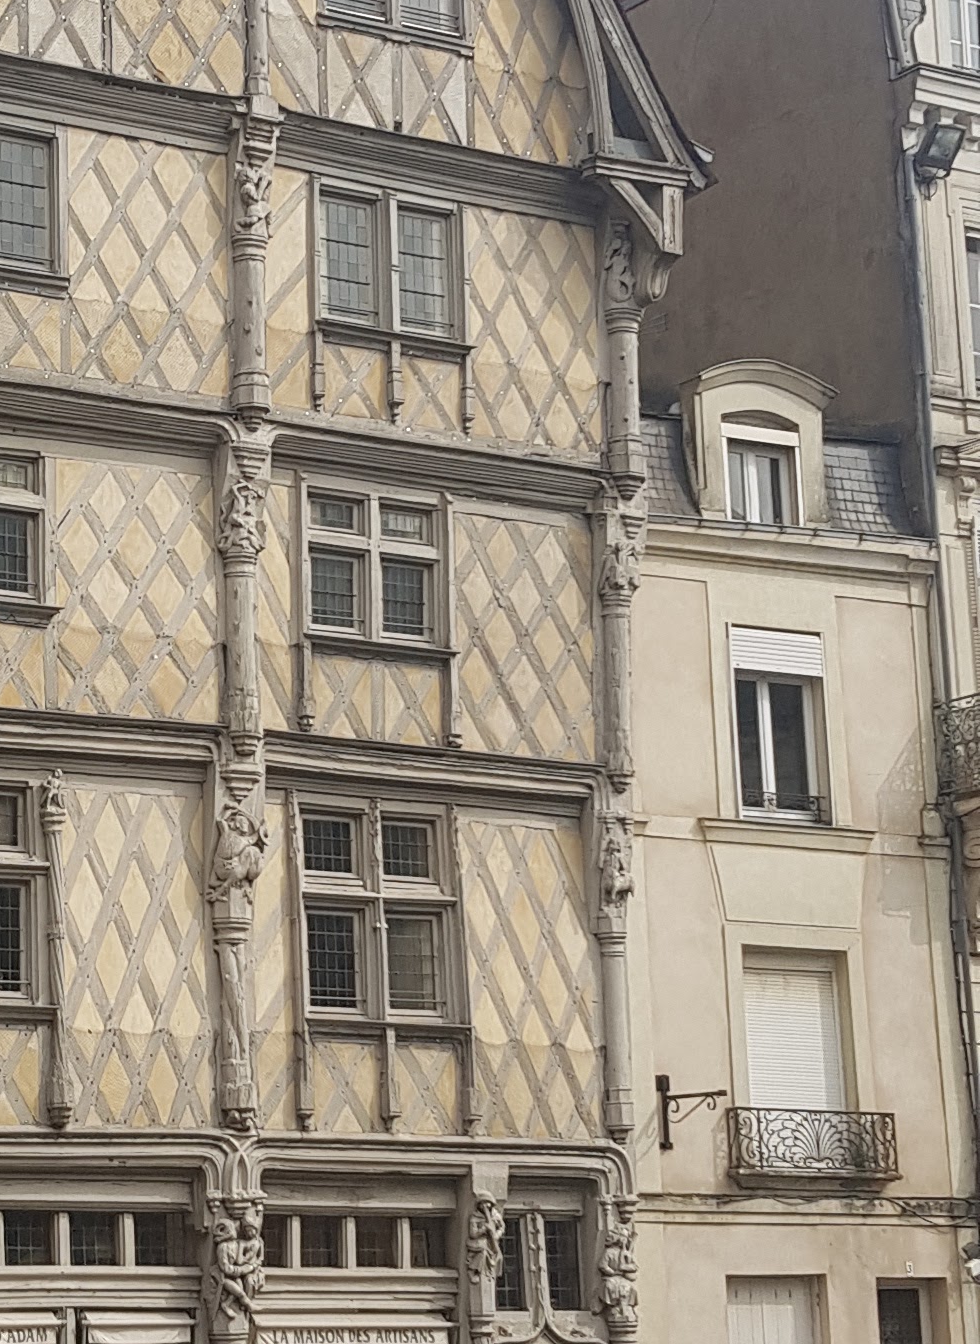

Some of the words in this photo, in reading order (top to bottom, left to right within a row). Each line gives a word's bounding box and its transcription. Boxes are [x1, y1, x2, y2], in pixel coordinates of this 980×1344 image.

[272, 1329, 288, 1344] LA
[293, 1329, 345, 1344] MAISON
[349, 1328, 370, 1343] DES
[376, 1328, 436, 1344] ARTISANS
